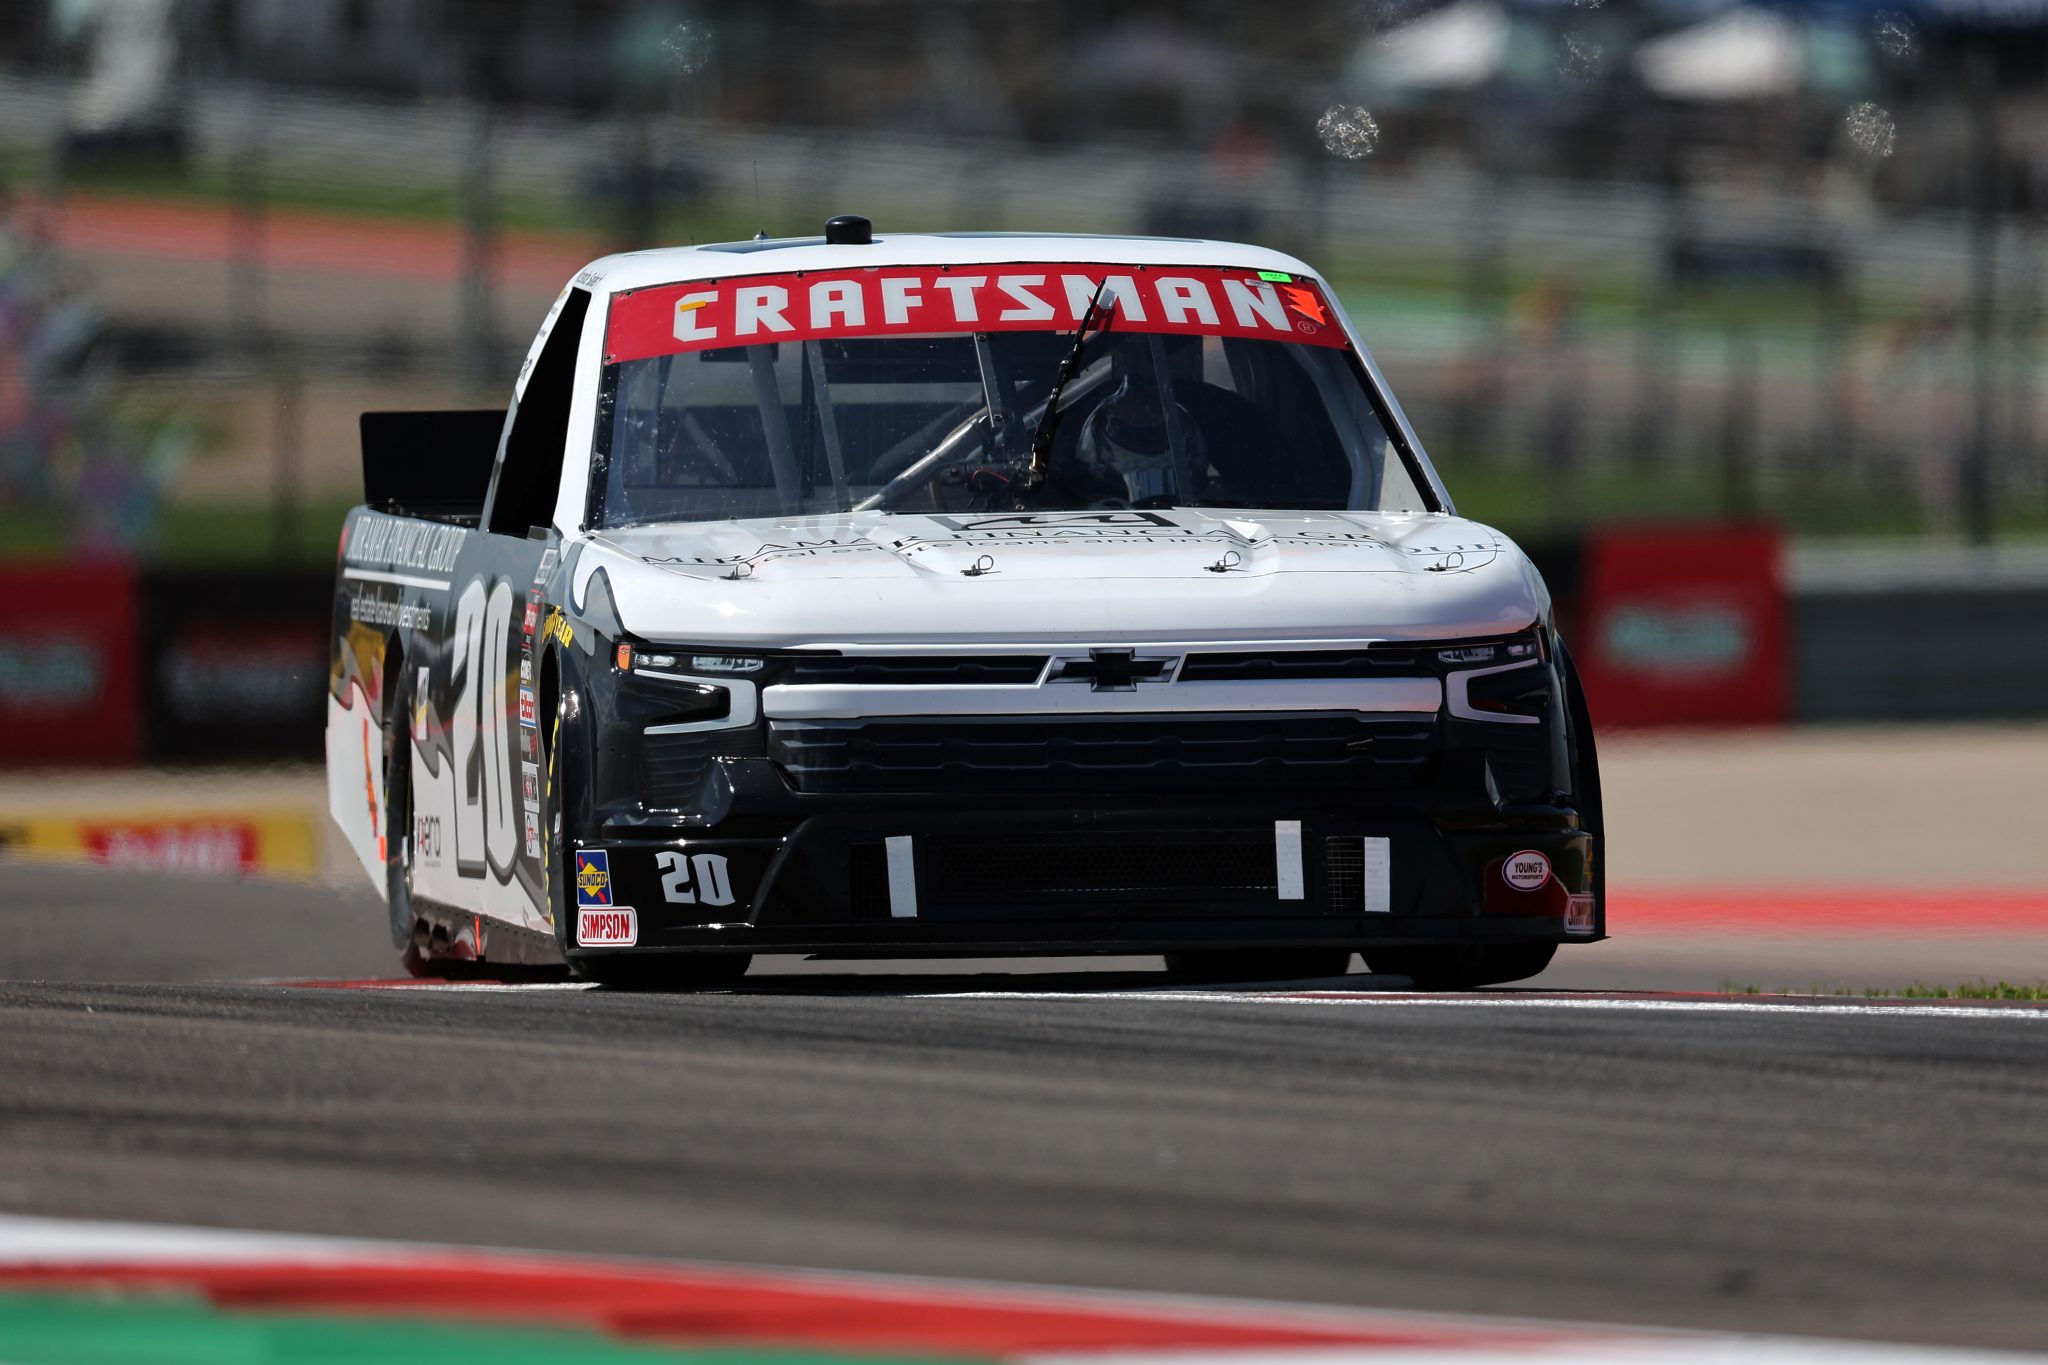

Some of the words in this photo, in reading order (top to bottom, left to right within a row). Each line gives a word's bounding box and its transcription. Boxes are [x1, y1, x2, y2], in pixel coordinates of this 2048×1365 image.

[672, 274, 1293, 342] CRAFTSMAN
[578, 873, 607, 888] SUNOCO
[655, 851, 736, 907] 20
[1514, 862, 1543, 873] YOUNG'S
[581, 913, 630, 940] SIMPSON
